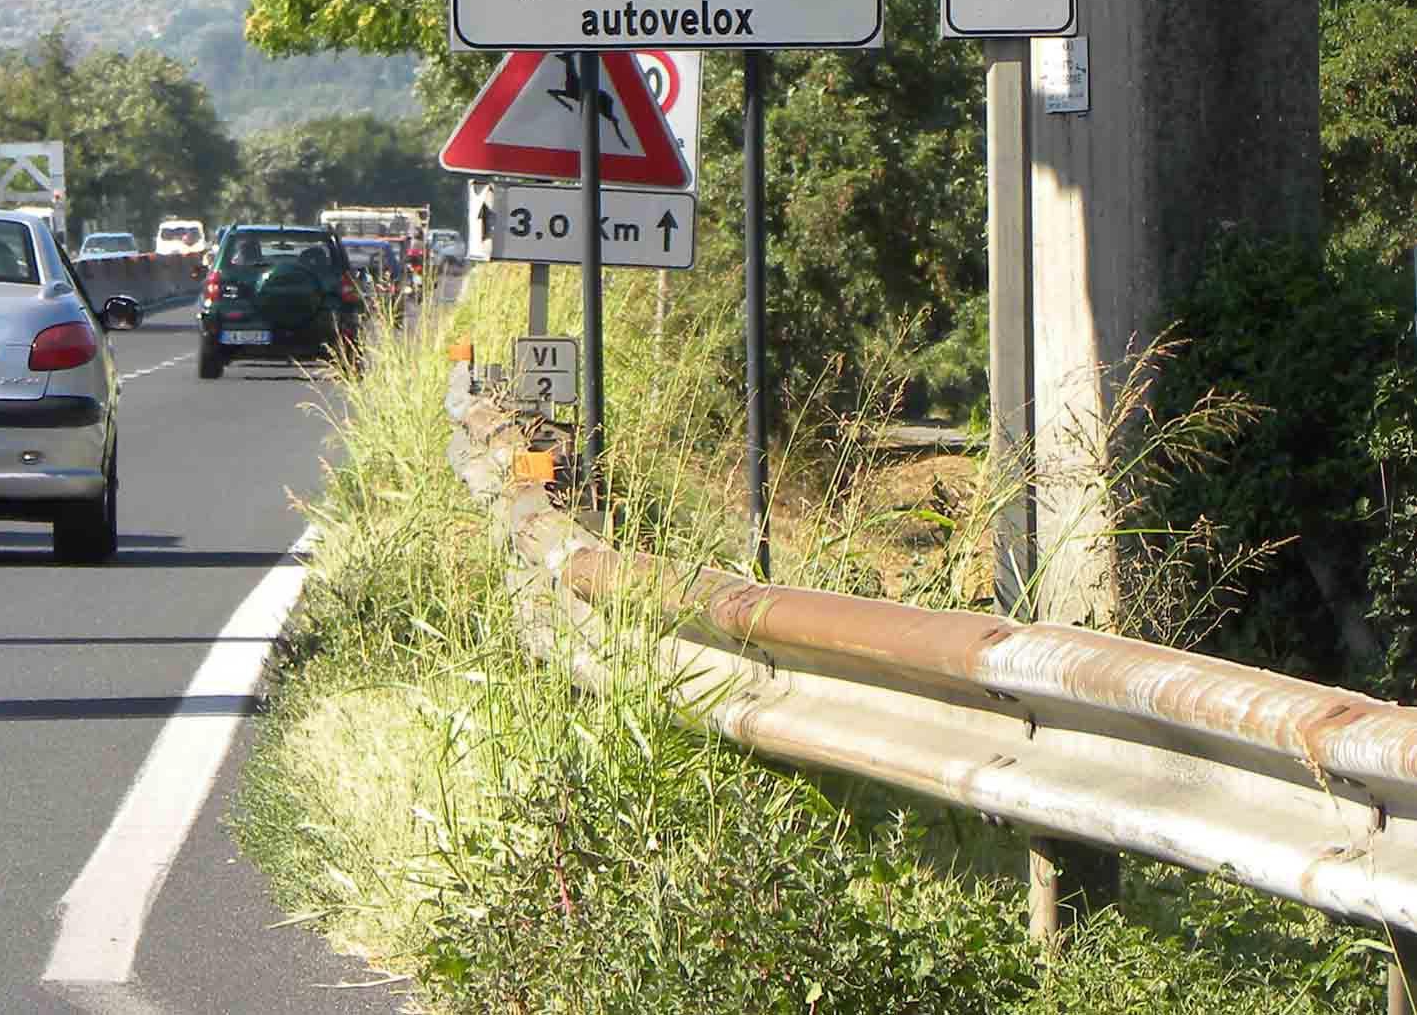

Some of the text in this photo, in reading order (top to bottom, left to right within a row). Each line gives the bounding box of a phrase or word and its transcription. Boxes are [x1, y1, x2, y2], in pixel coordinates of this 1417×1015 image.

[581, 1, 754, 36] autovelox
[509, 207, 570, 241] 3.0
[532, 347, 557, 366] VI
[536, 376, 553, 401] 2
